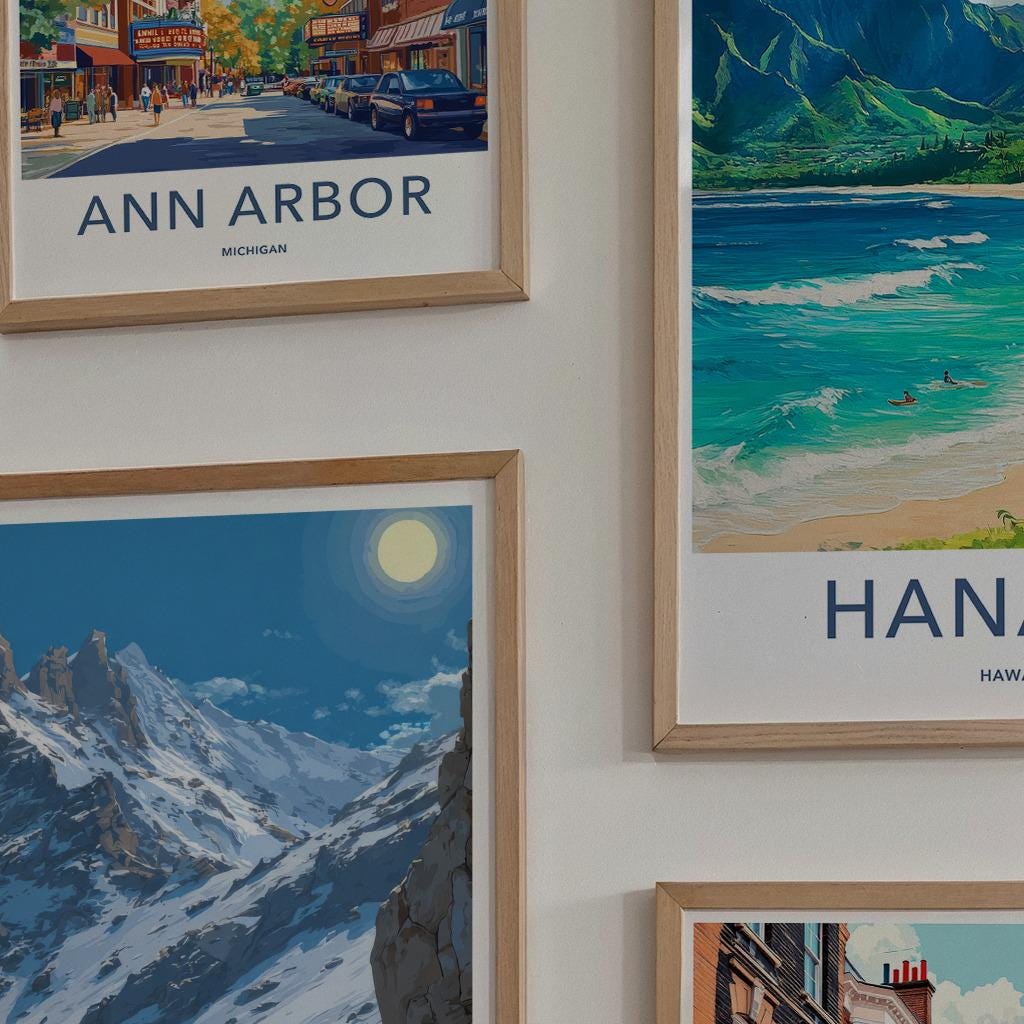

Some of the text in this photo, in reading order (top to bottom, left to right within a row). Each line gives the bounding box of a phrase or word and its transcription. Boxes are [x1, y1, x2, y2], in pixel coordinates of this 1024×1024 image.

[77, 175, 432, 236] ANN ARBOR
[221, 243, 288, 258] MICHIGAN
[826, 576, 1024, 639] HAN
[980, 668, 1024, 682] HAW
